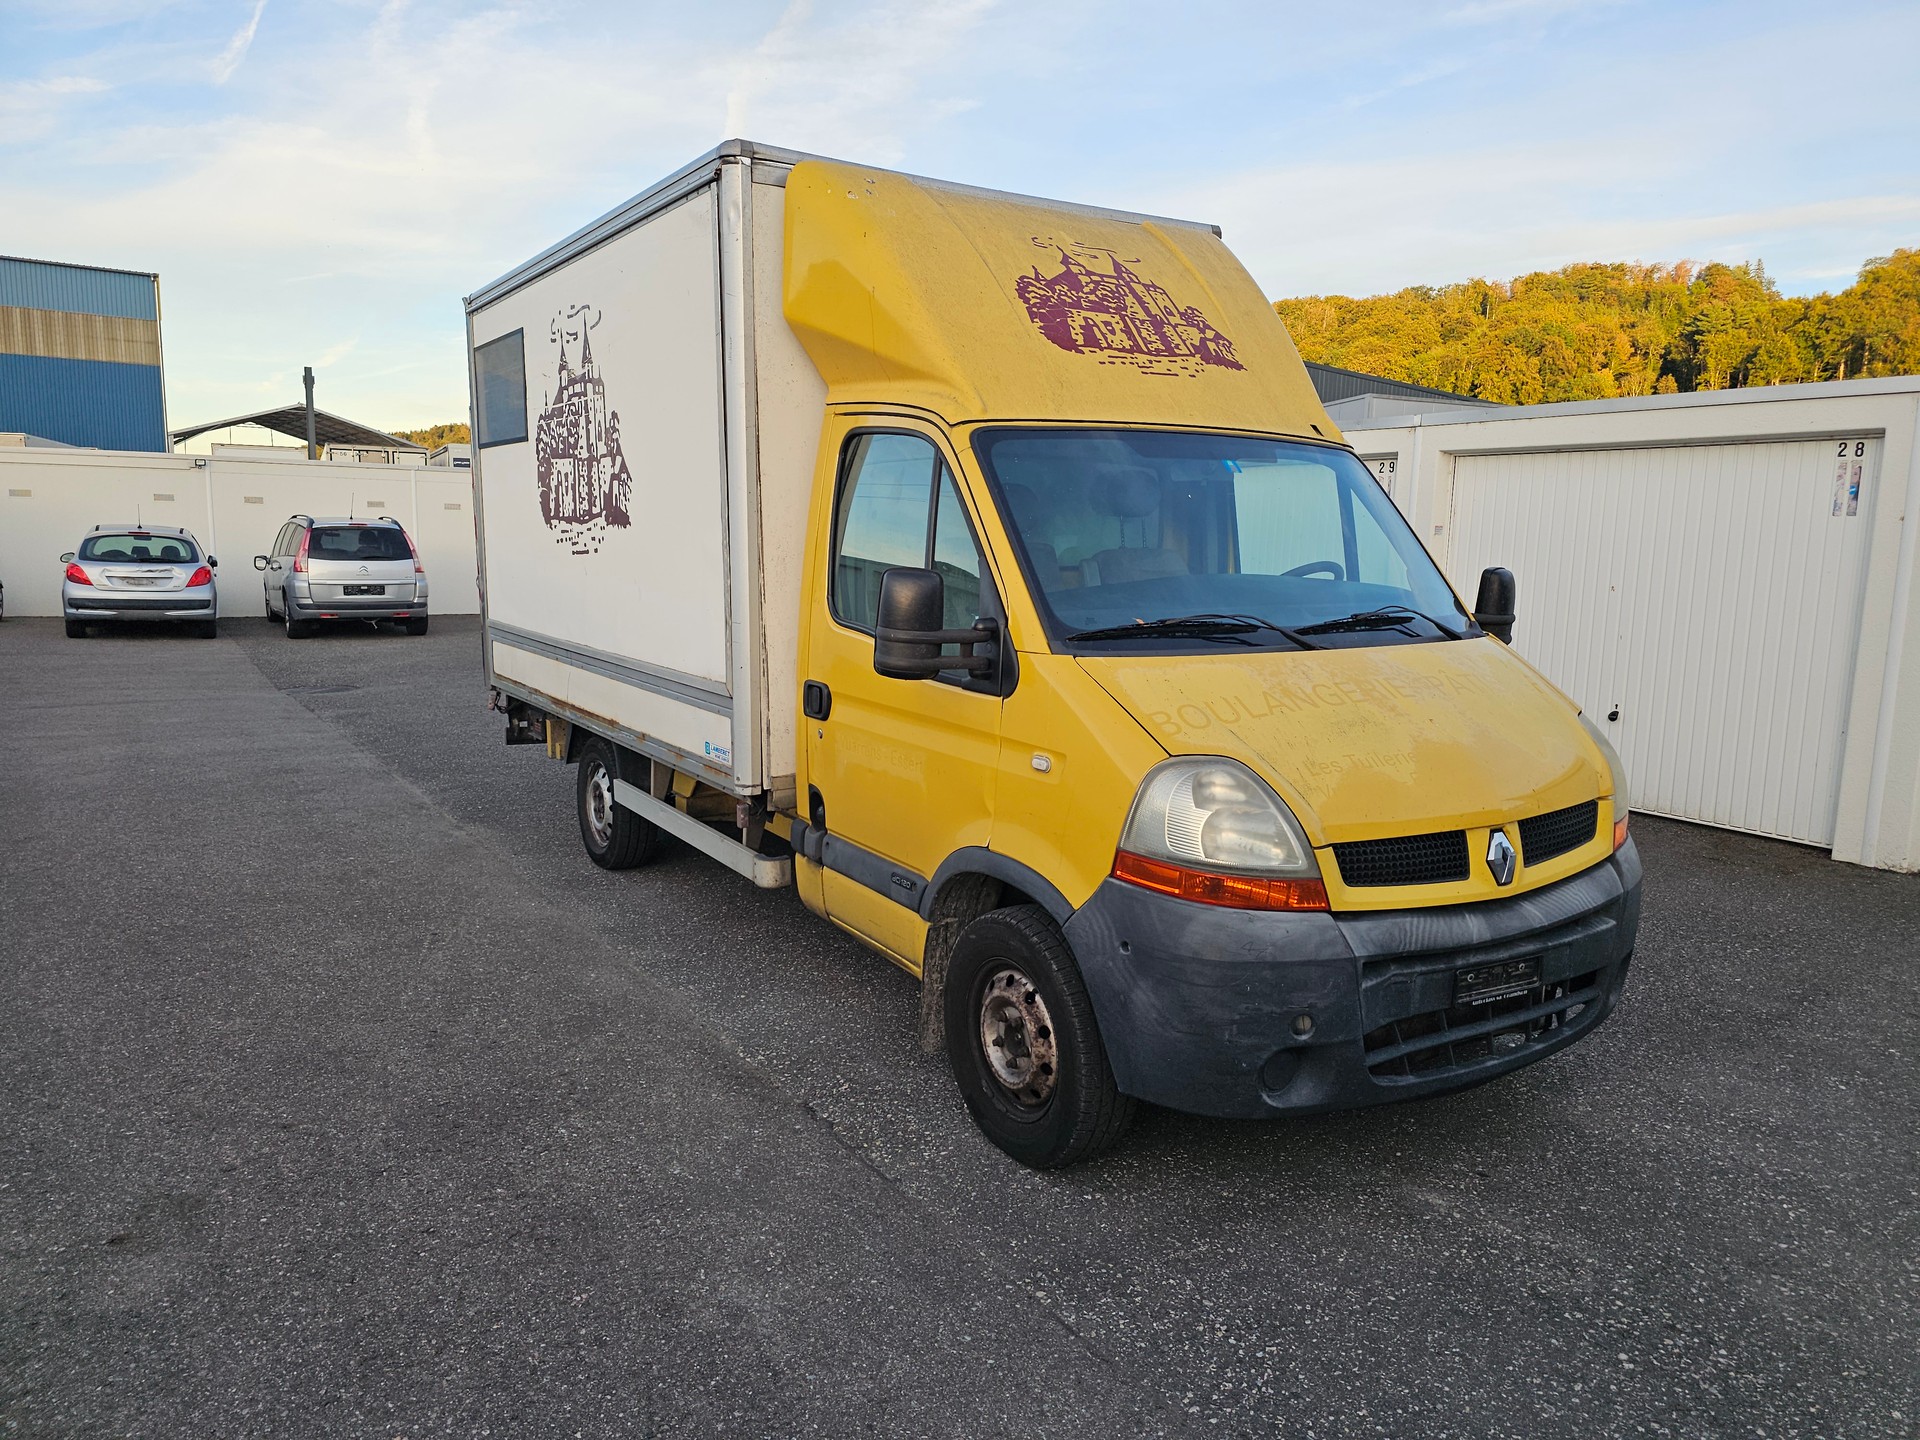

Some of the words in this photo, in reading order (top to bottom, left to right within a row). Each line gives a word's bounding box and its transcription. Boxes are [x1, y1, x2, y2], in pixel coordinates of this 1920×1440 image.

[1837, 441, 1865, 458] 28
[1378, 461, 1395, 474] 29
[1148, 675, 1416, 736] BOULANGERIE
[1302, 756, 1343, 777] Les
[901, 879, 912, 889] 120
